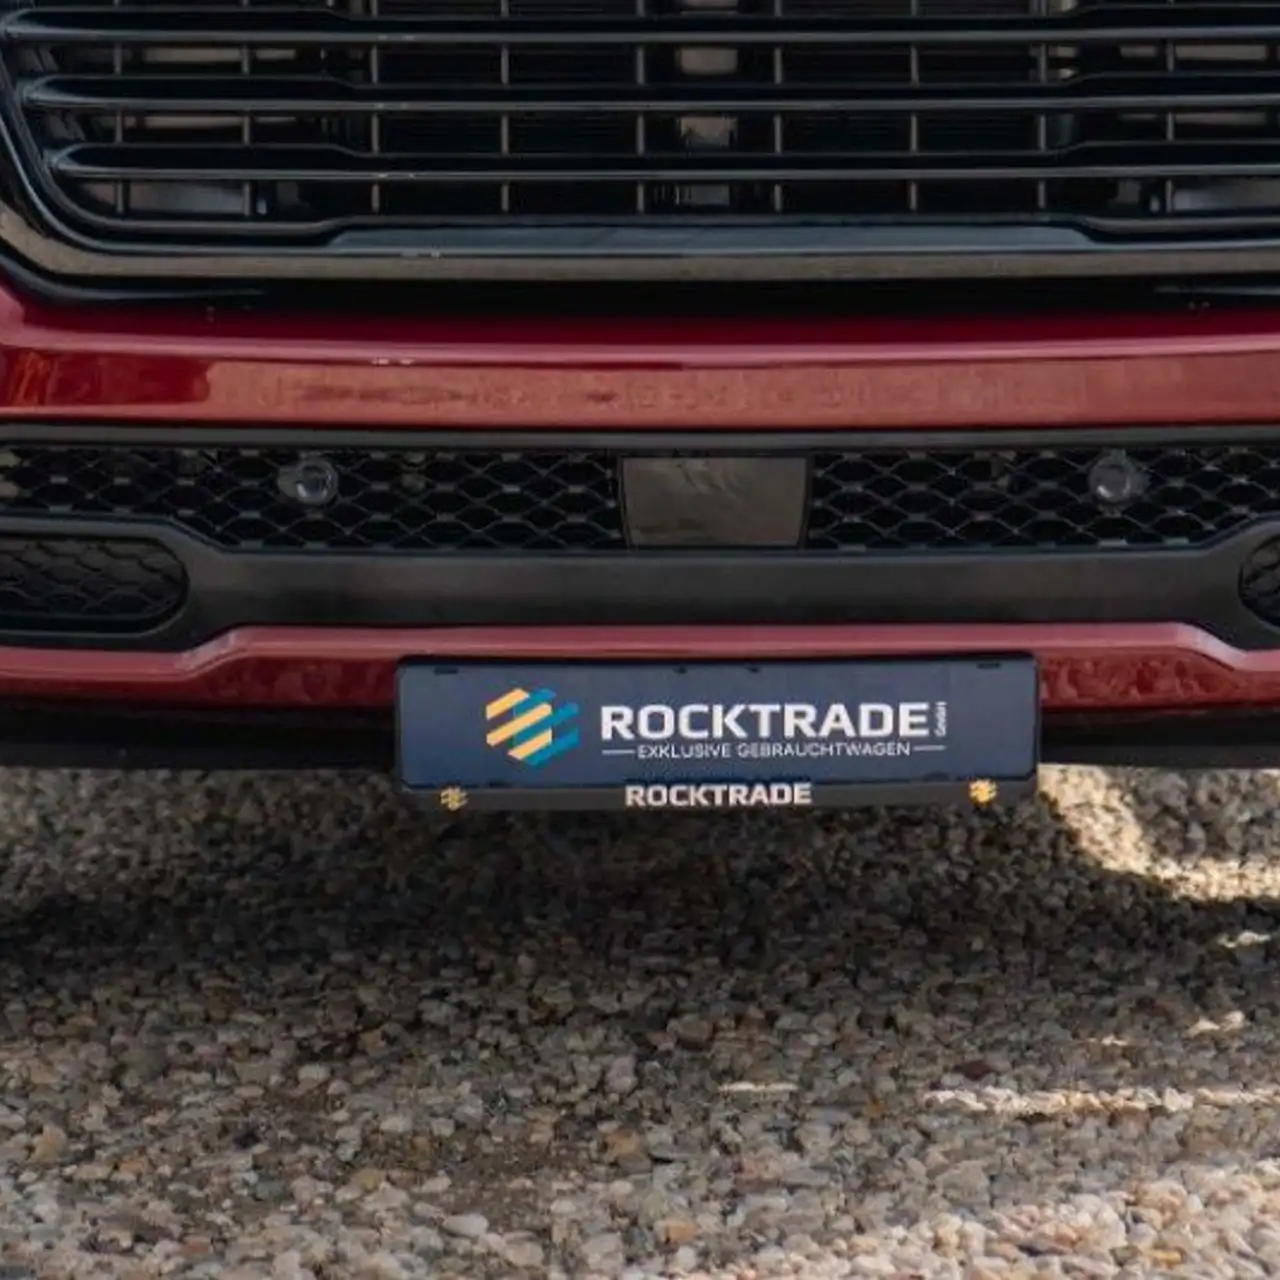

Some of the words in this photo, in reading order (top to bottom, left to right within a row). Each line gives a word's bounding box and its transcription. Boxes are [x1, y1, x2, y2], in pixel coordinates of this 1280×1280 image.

[600, 701, 930, 740] ROCKTRADE
[637, 743, 732, 759] EXKLUSIVE
[737, 741, 911, 758] GEBRAUCHTWAGEN
[624, 782, 813, 807] ROCKTRADE
